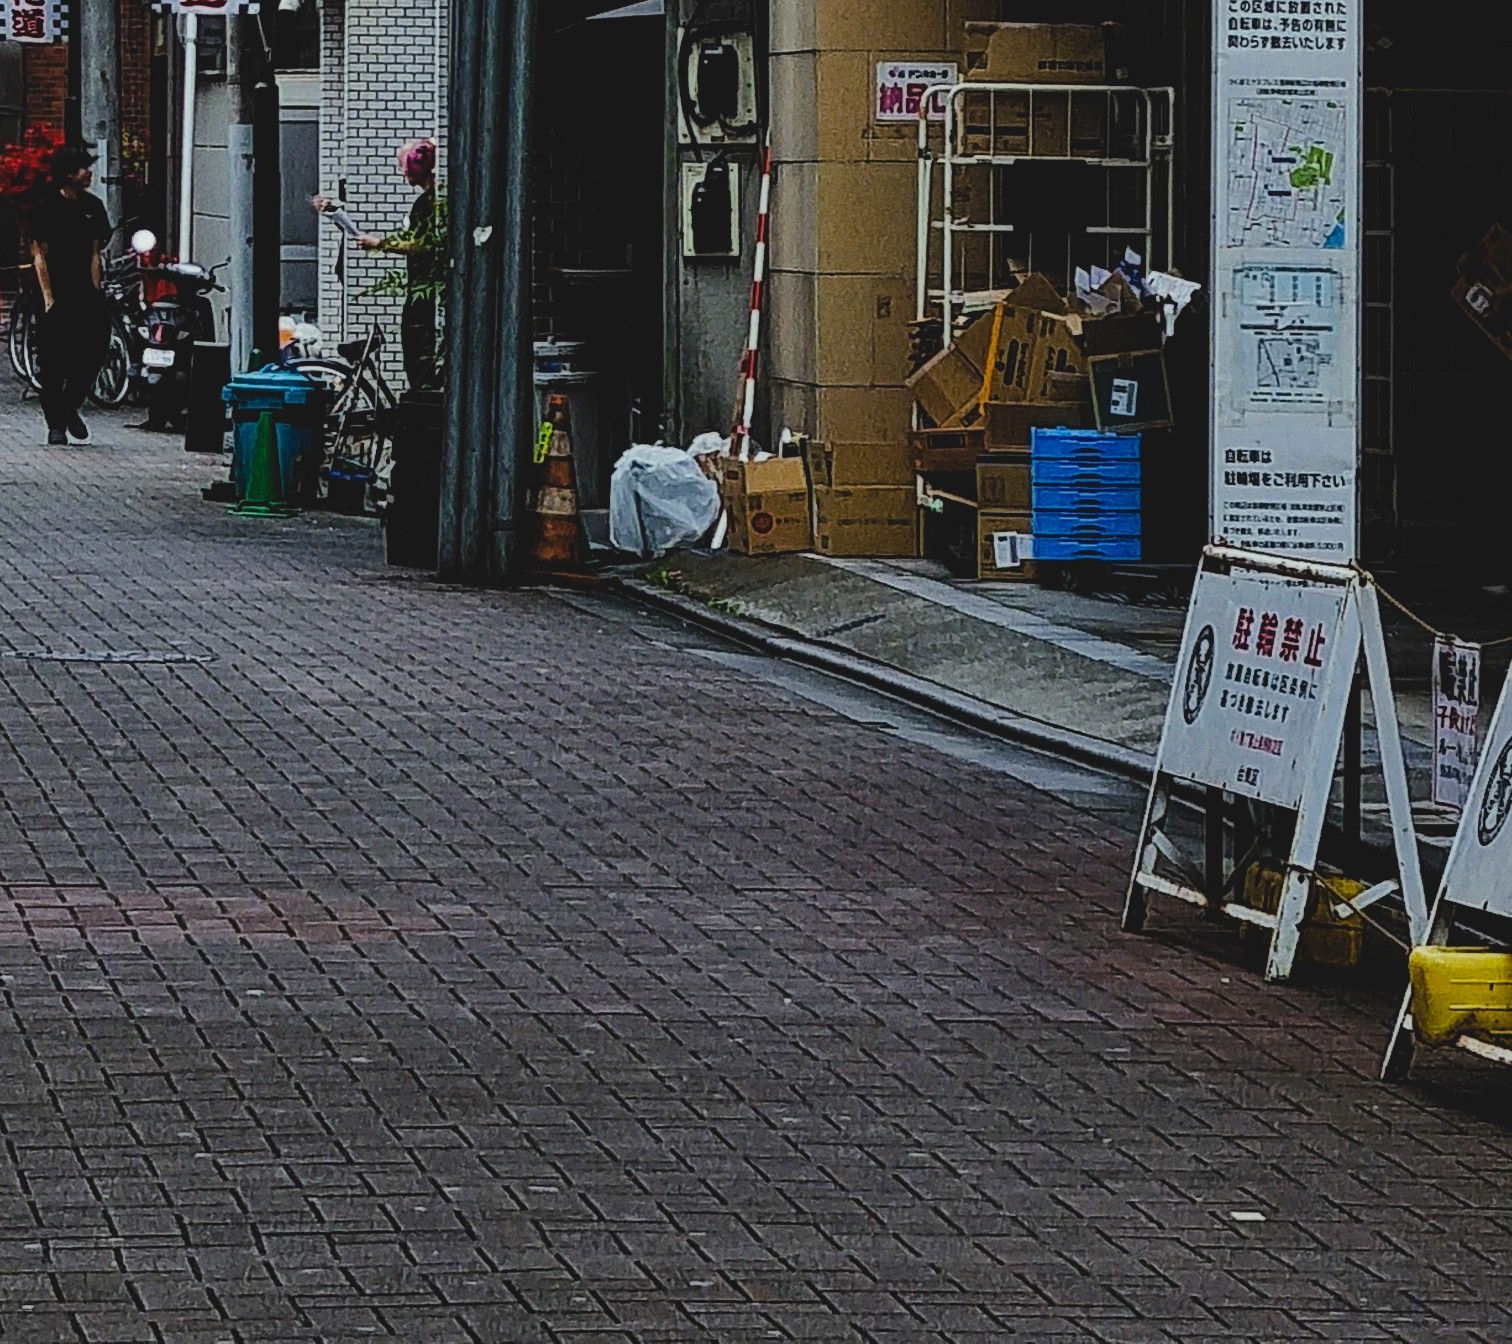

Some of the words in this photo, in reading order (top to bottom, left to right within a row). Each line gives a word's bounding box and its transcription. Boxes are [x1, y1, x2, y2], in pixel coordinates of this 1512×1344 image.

[1228, 0, 1346, 15] この区域に放置された
[1225, 448, 1272, 464] 自転車は
[1224, 470, 1346, 488] 駐輪場をご利用下さい
[1232, 607, 1326, 668] 駐輪禁止
